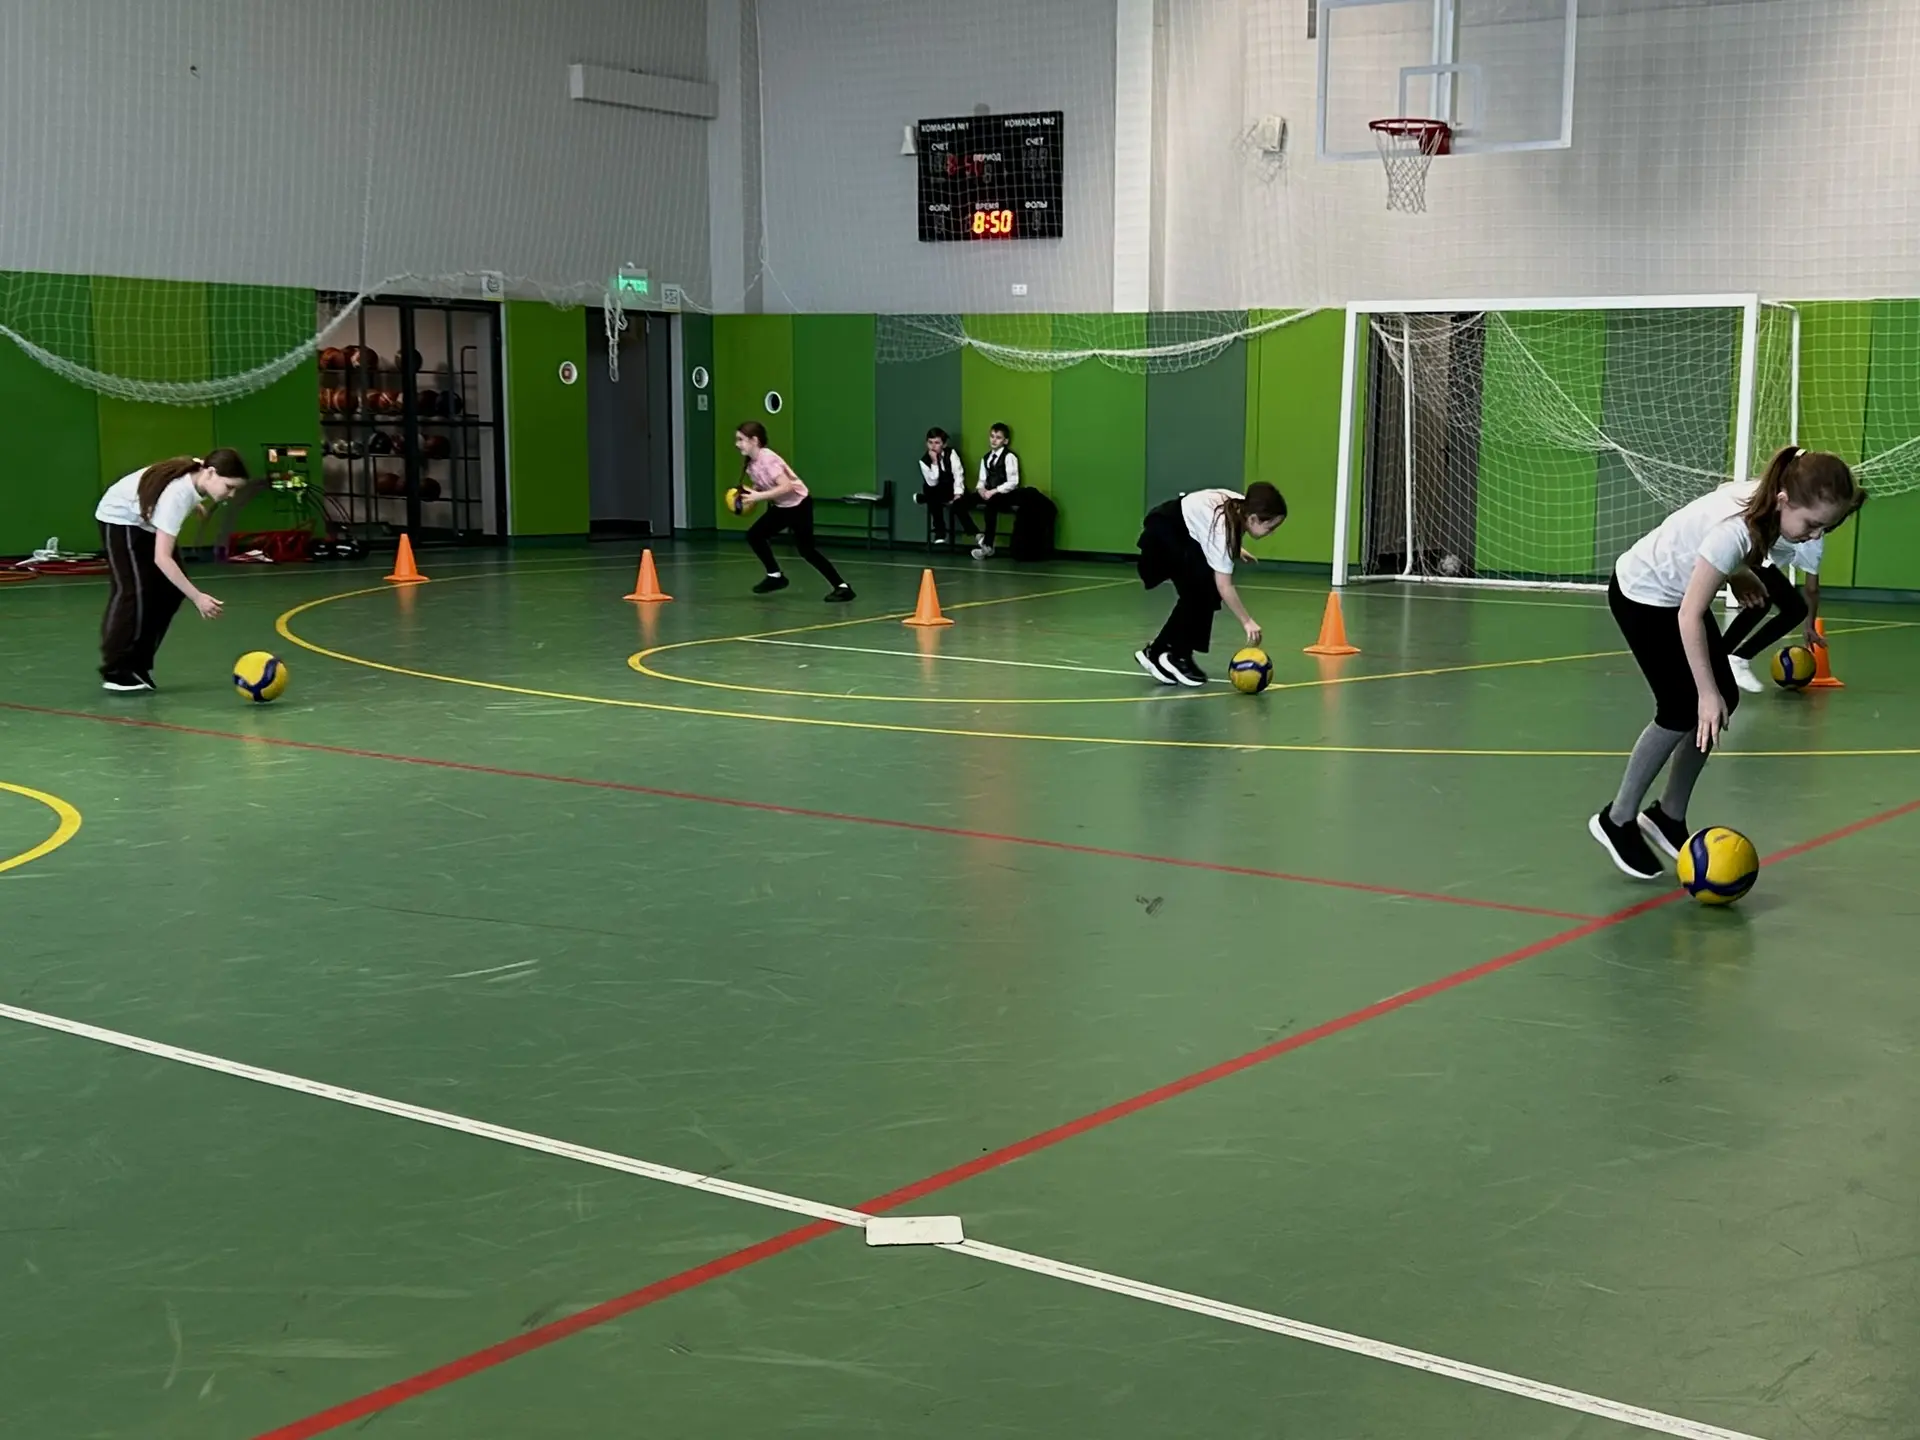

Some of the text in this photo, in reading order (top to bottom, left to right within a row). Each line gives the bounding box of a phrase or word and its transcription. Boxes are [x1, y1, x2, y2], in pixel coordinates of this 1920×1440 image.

[921, 122, 956, 132] КОМАНДА
[1004, 118, 1040, 127] КОМАНДА
[973, 210, 1012, 234] 8:50
